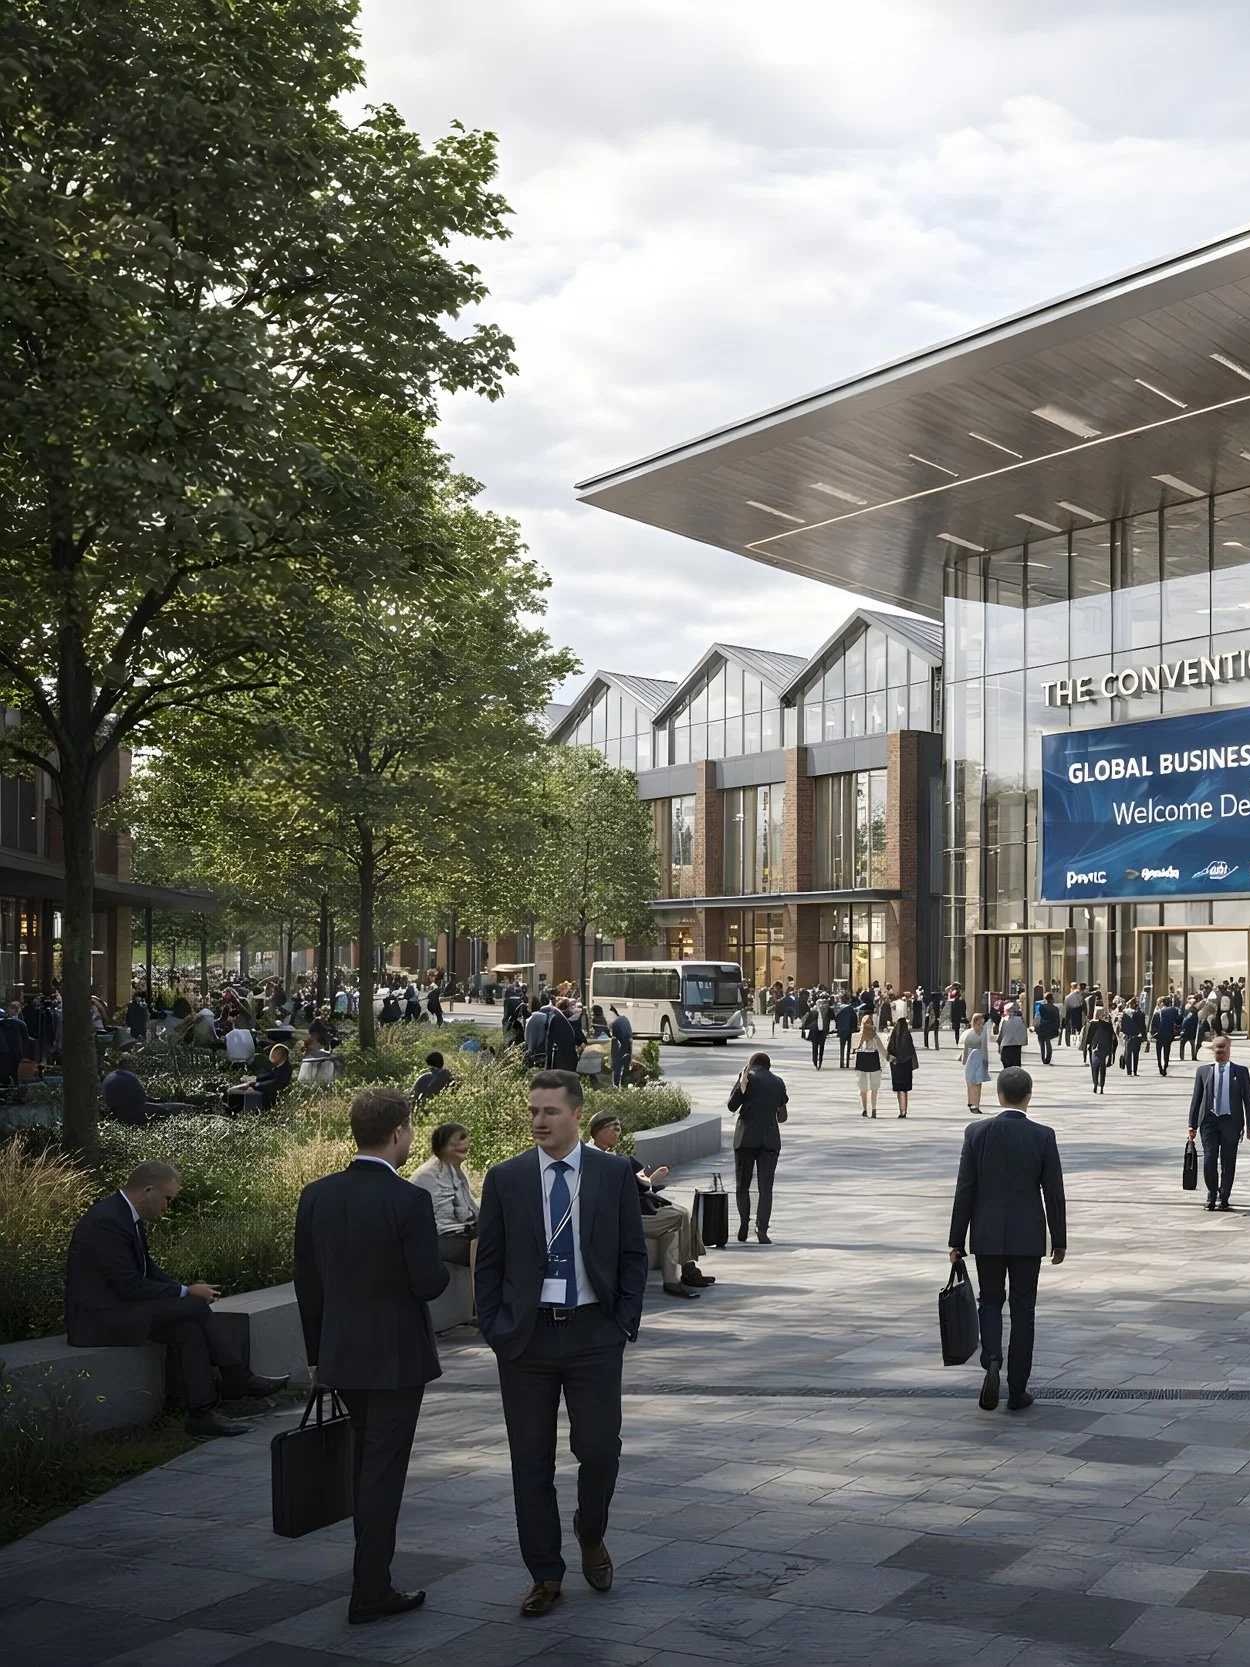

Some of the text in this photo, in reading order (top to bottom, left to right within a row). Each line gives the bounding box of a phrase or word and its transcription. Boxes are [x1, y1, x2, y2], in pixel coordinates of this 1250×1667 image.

[1041, 680, 1092, 707] THE
[1068, 755, 1153, 784] GLOBAL
[1112, 800, 1213, 826] Welcome
